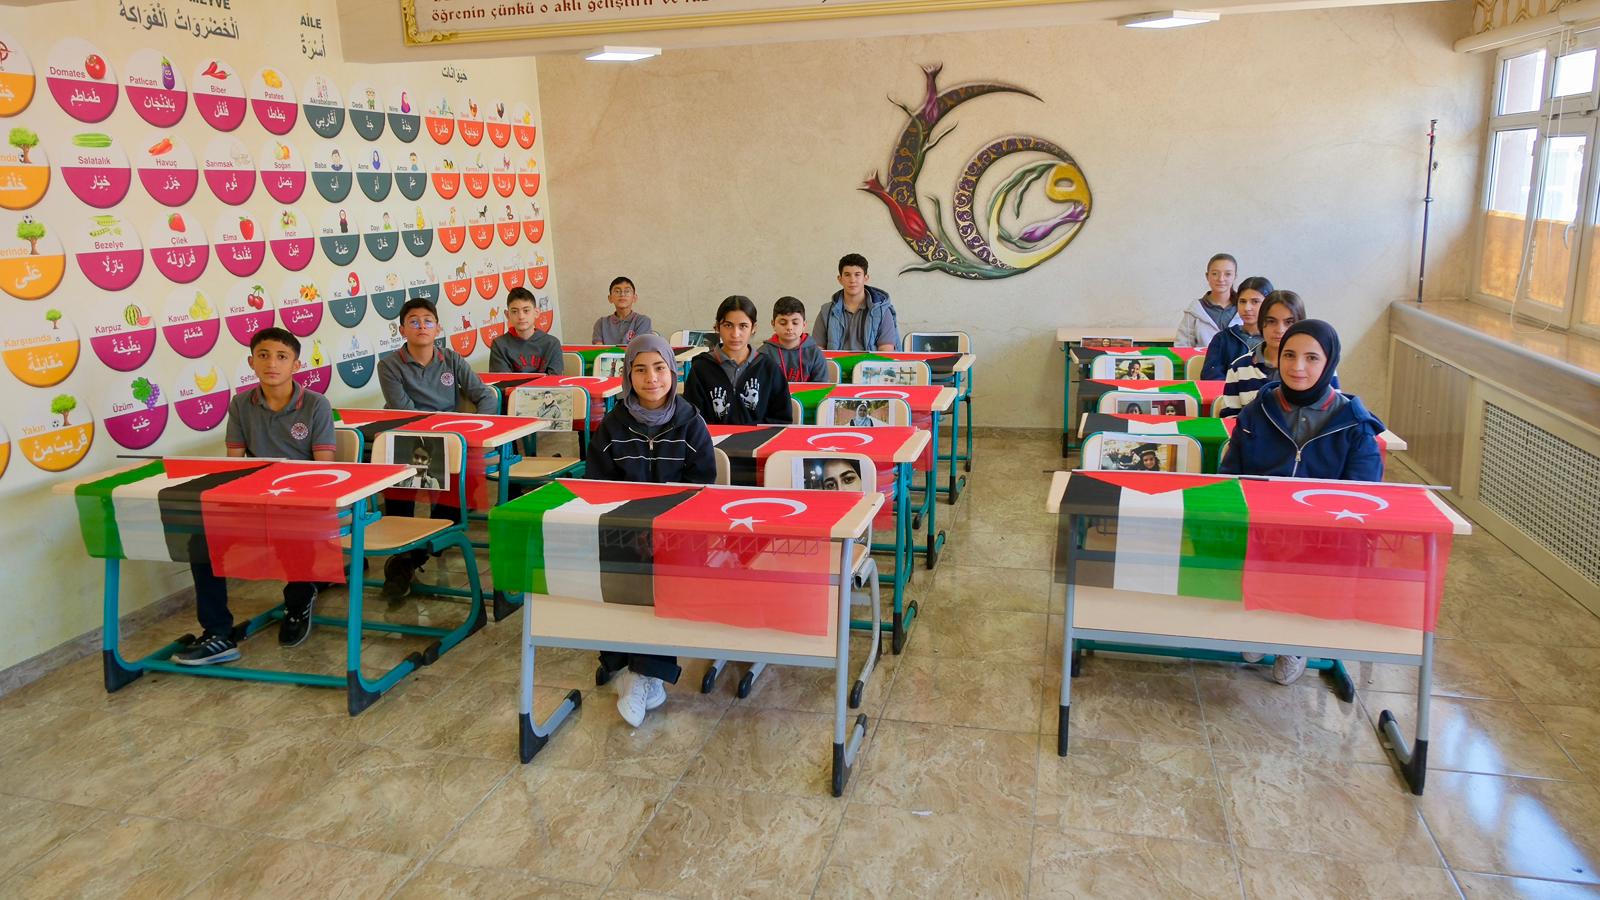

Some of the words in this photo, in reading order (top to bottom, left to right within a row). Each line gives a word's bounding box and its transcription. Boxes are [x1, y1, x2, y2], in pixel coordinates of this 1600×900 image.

[432, 6, 485, 23] öğrenin
[491, 3, 535, 20] çünkü
[540, 4, 548, 14] o
[300, 12, 322, 30] AİLE
[49, 66, 86, 79] Domates
[129, 75, 158, 87] Patlıcan
[210, 84, 227, 94] Biber
[264, 91, 285, 101] Patates
[78, 156, 111, 165] Salatalık
[156, 158, 177, 168] Havuç
[206, 160, 234, 168] Sarımsak
[171, 236, 188, 245] Çilek
[223, 233, 237, 241] Elma
[95, 241, 124, 252] Bezelye
[168, 314, 189, 323] Kavun
[95, 324, 122, 334] Karpuz
[180, 389, 194, 397] Muz
[113, 401, 133, 412] Üzüm
[22, 425, 46, 435] Yakın
